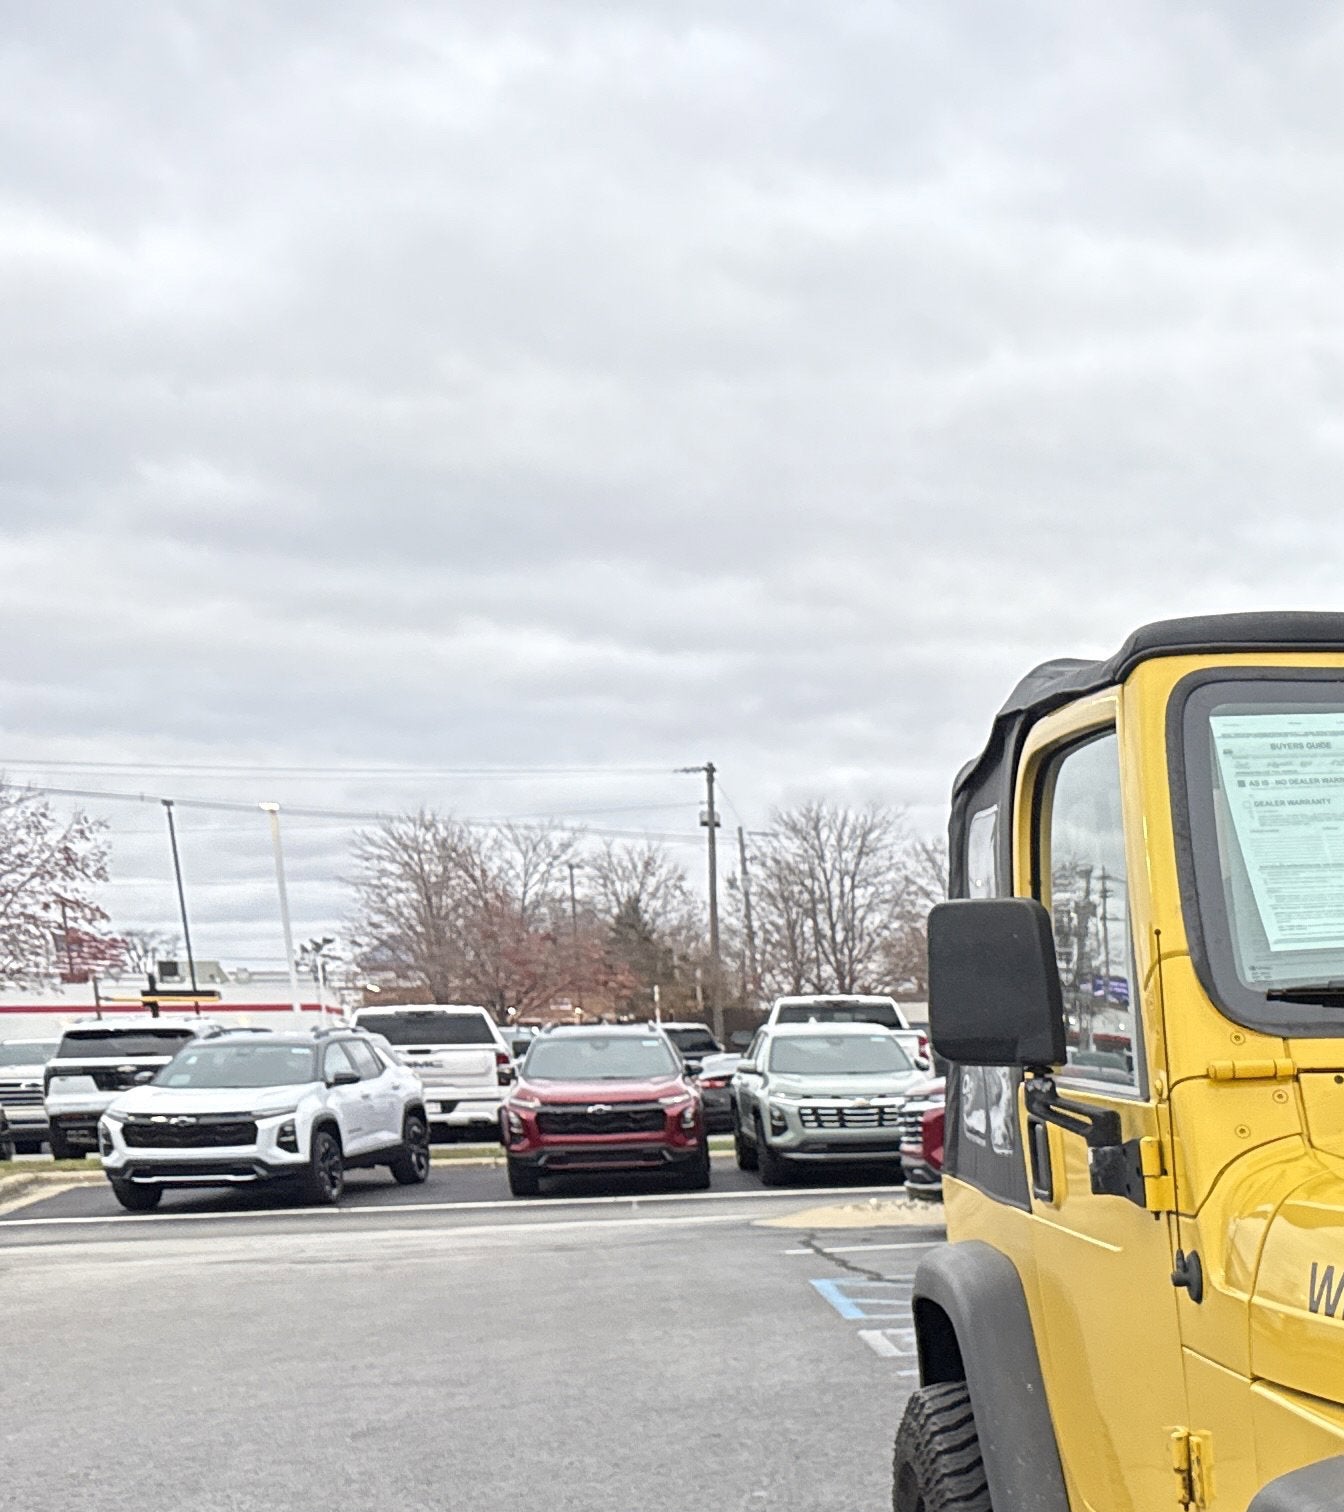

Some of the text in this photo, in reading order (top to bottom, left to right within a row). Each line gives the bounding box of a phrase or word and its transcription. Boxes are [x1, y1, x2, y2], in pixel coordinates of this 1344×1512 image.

[1270, 741, 1332, 751] BUYERS GUIDE
[1275, 778, 1286, 786] NO
[1289, 777, 1320, 785] DEALER
[1254, 797, 1332, 808] DEALER WARRANTY
